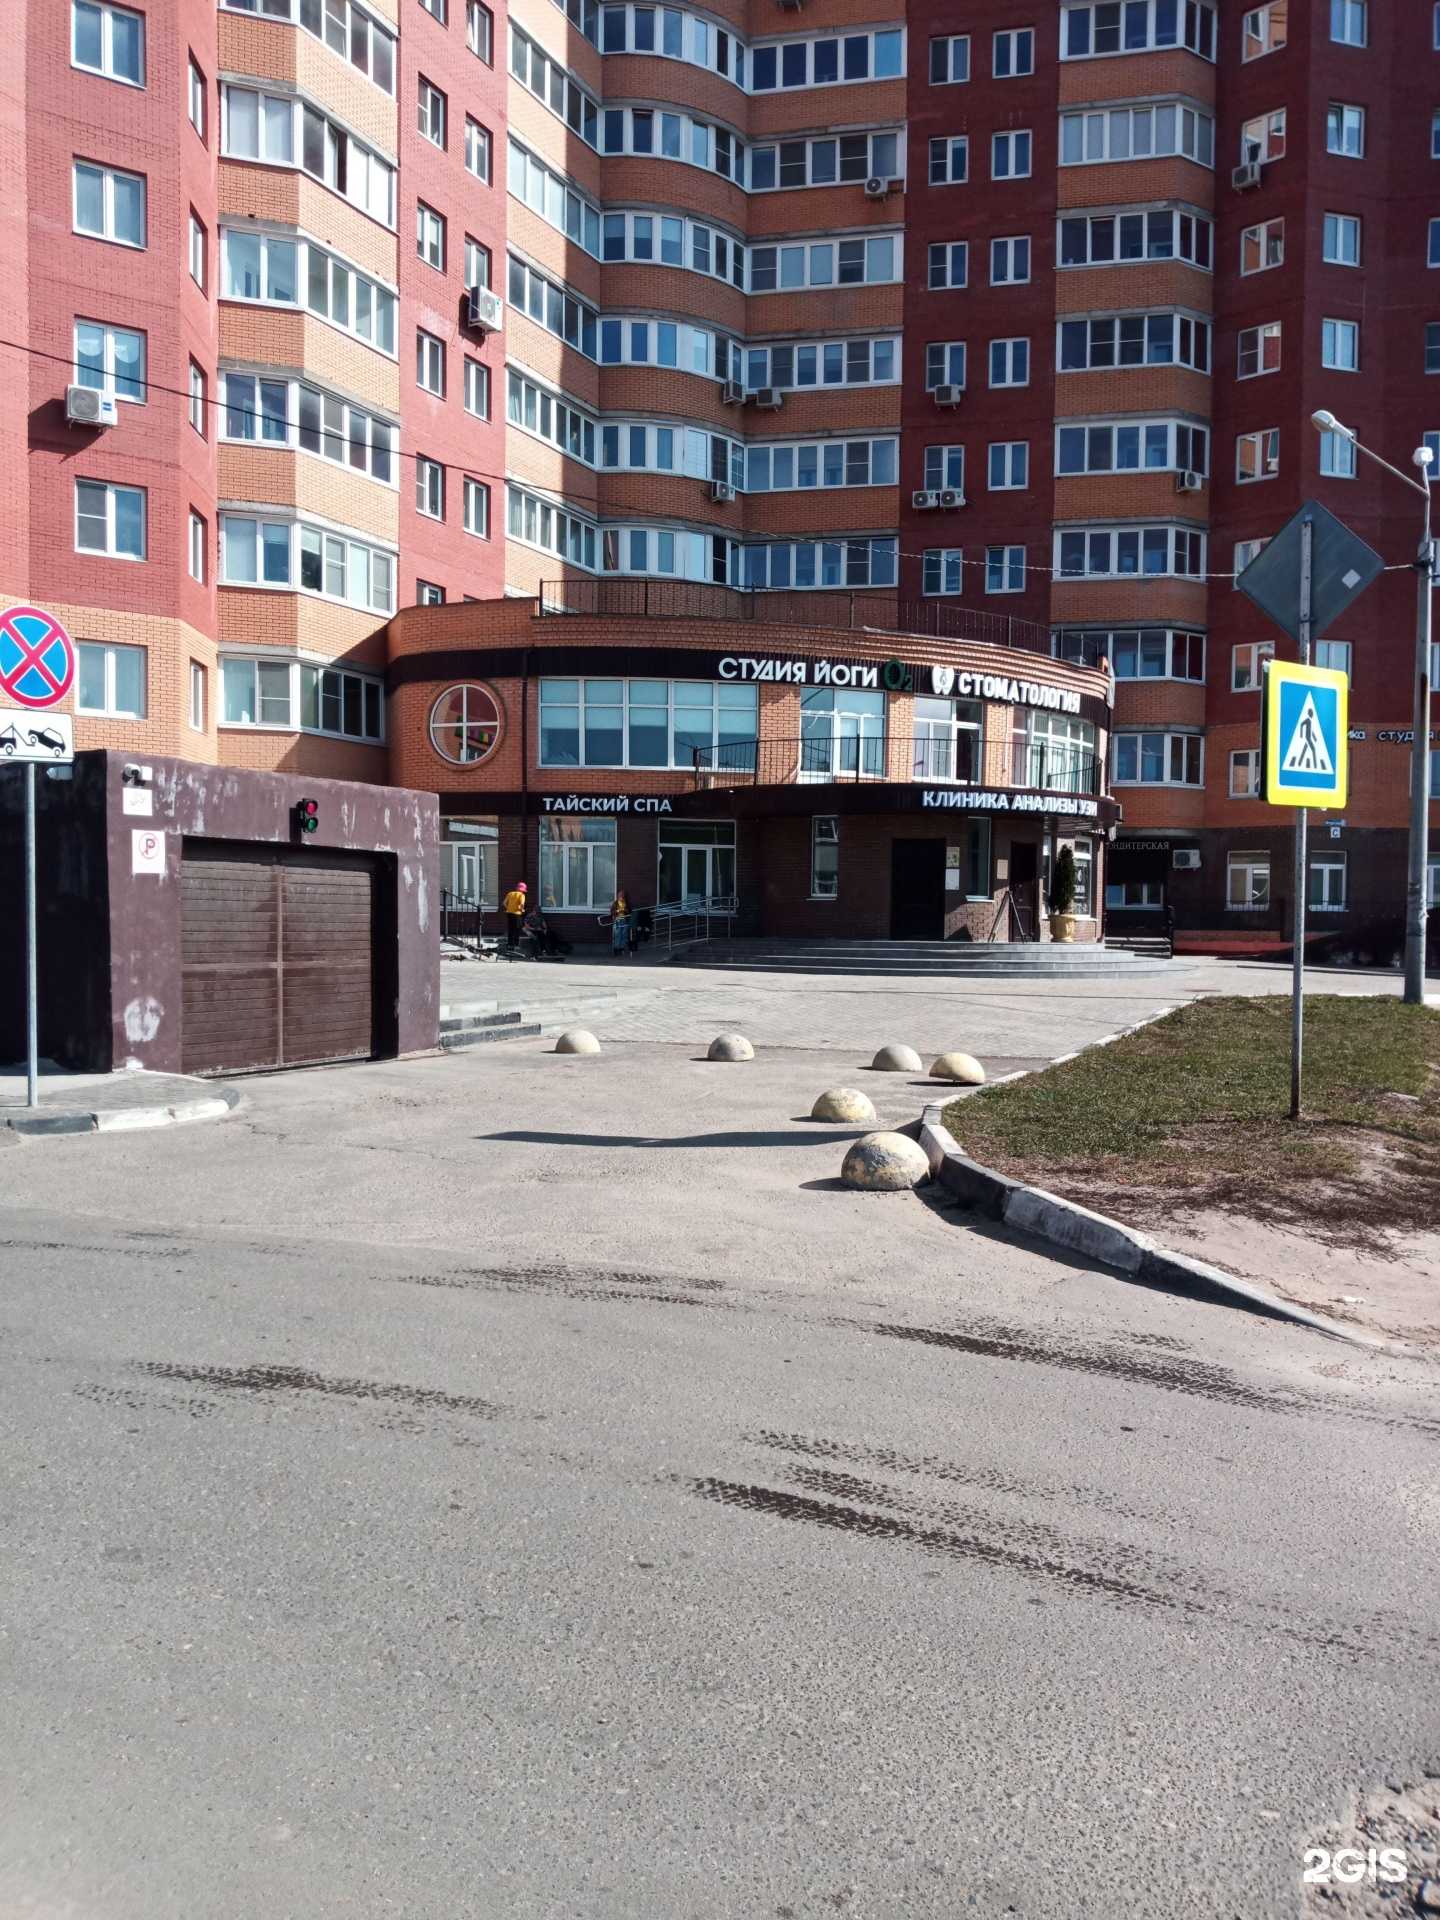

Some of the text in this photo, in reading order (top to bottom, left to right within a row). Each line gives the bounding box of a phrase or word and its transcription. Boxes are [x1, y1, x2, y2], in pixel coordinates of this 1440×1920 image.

[718, 657, 806, 683] СТУДИЯ
[814, 660, 878, 688] ЙОГИ
[958, 672, 1081, 714] СТОМАТОЛОГИЯ
[543, 795, 673, 812] ТАЙСКИЙ СПА
[922, 791, 1098, 816] КЛИНИКА АНАЛИЗЫ УЗИ
